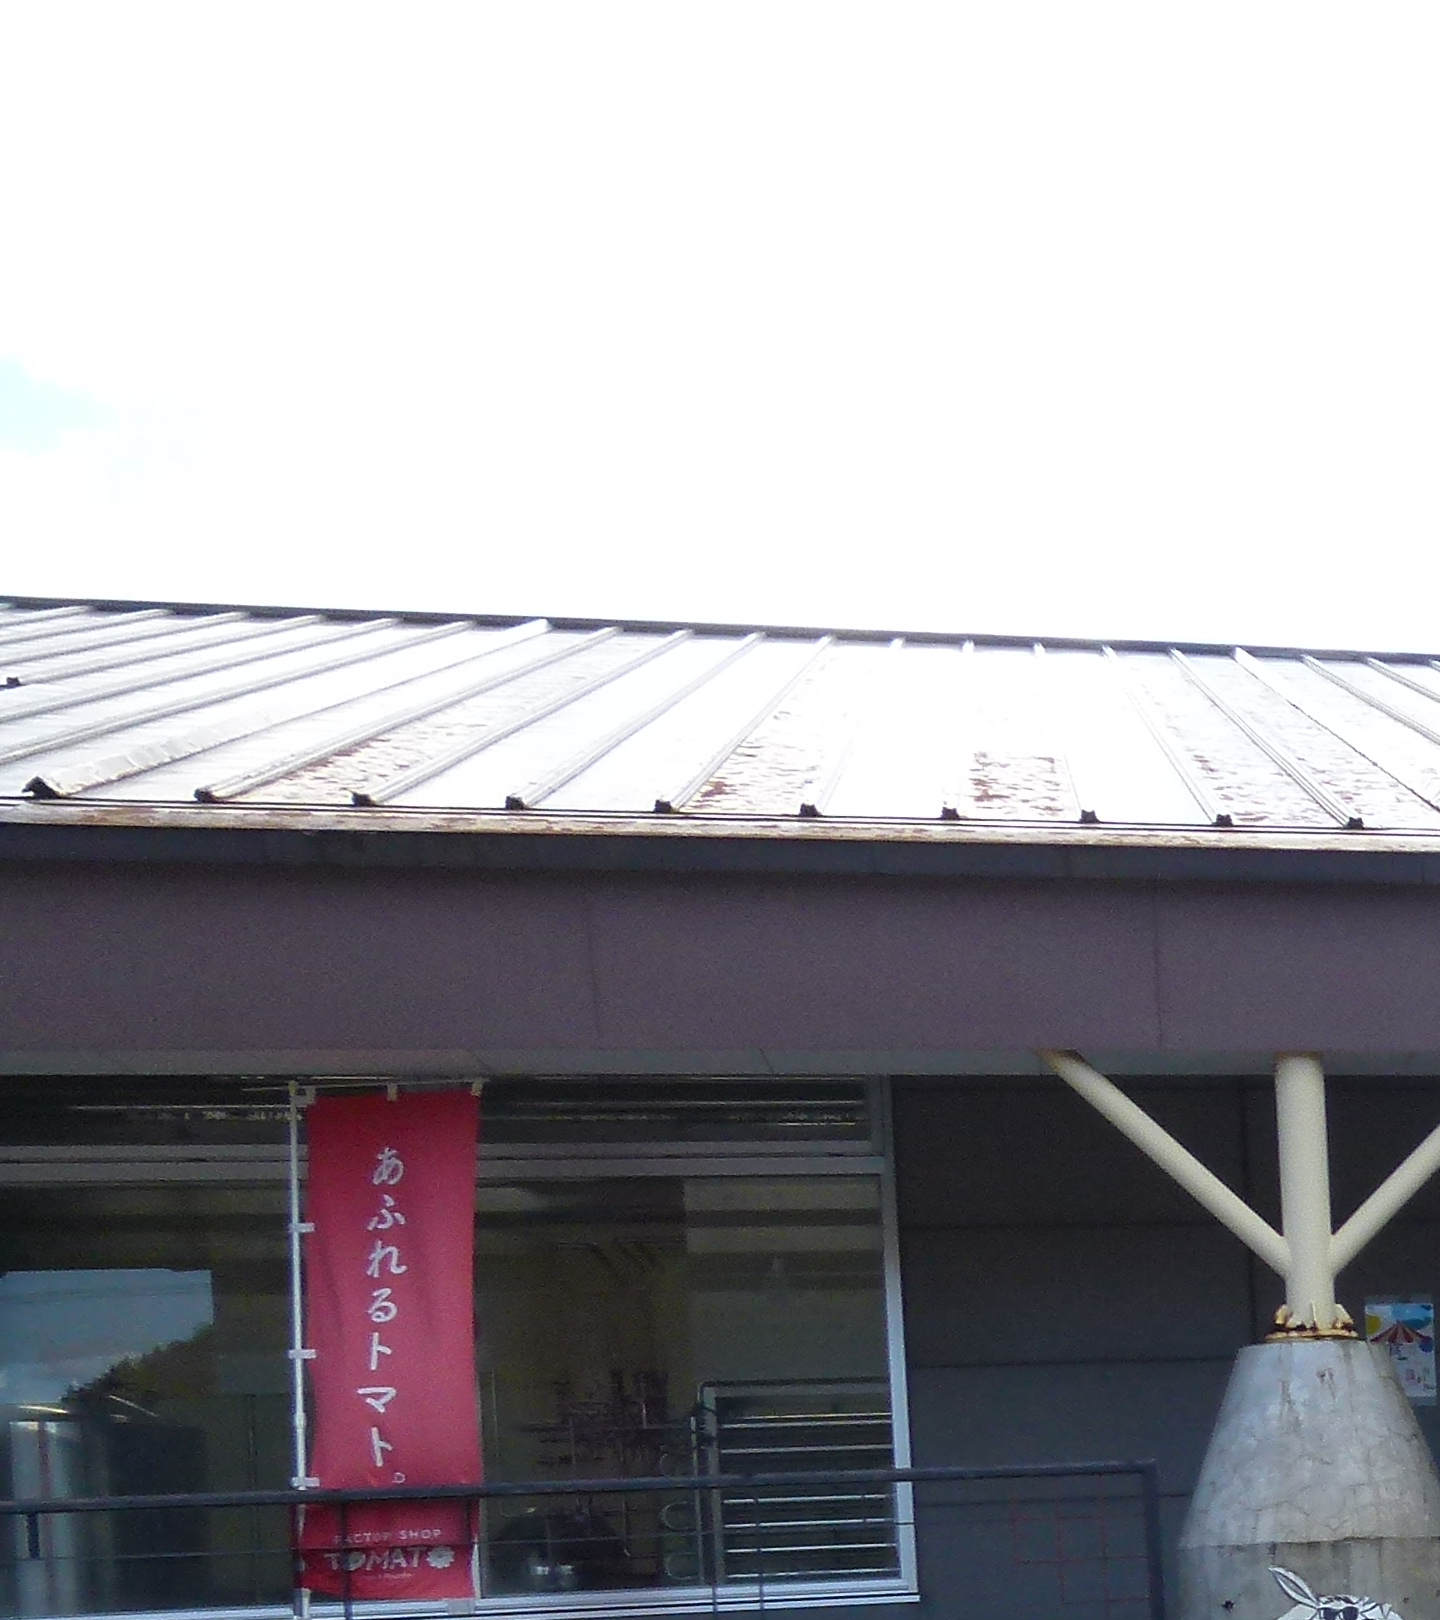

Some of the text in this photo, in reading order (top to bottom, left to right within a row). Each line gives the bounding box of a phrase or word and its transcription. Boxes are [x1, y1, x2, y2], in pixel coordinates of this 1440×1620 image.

[357, 1147, 407, 1484] あふれるトマト。
[400, 1529, 442, 1540] SHOP
